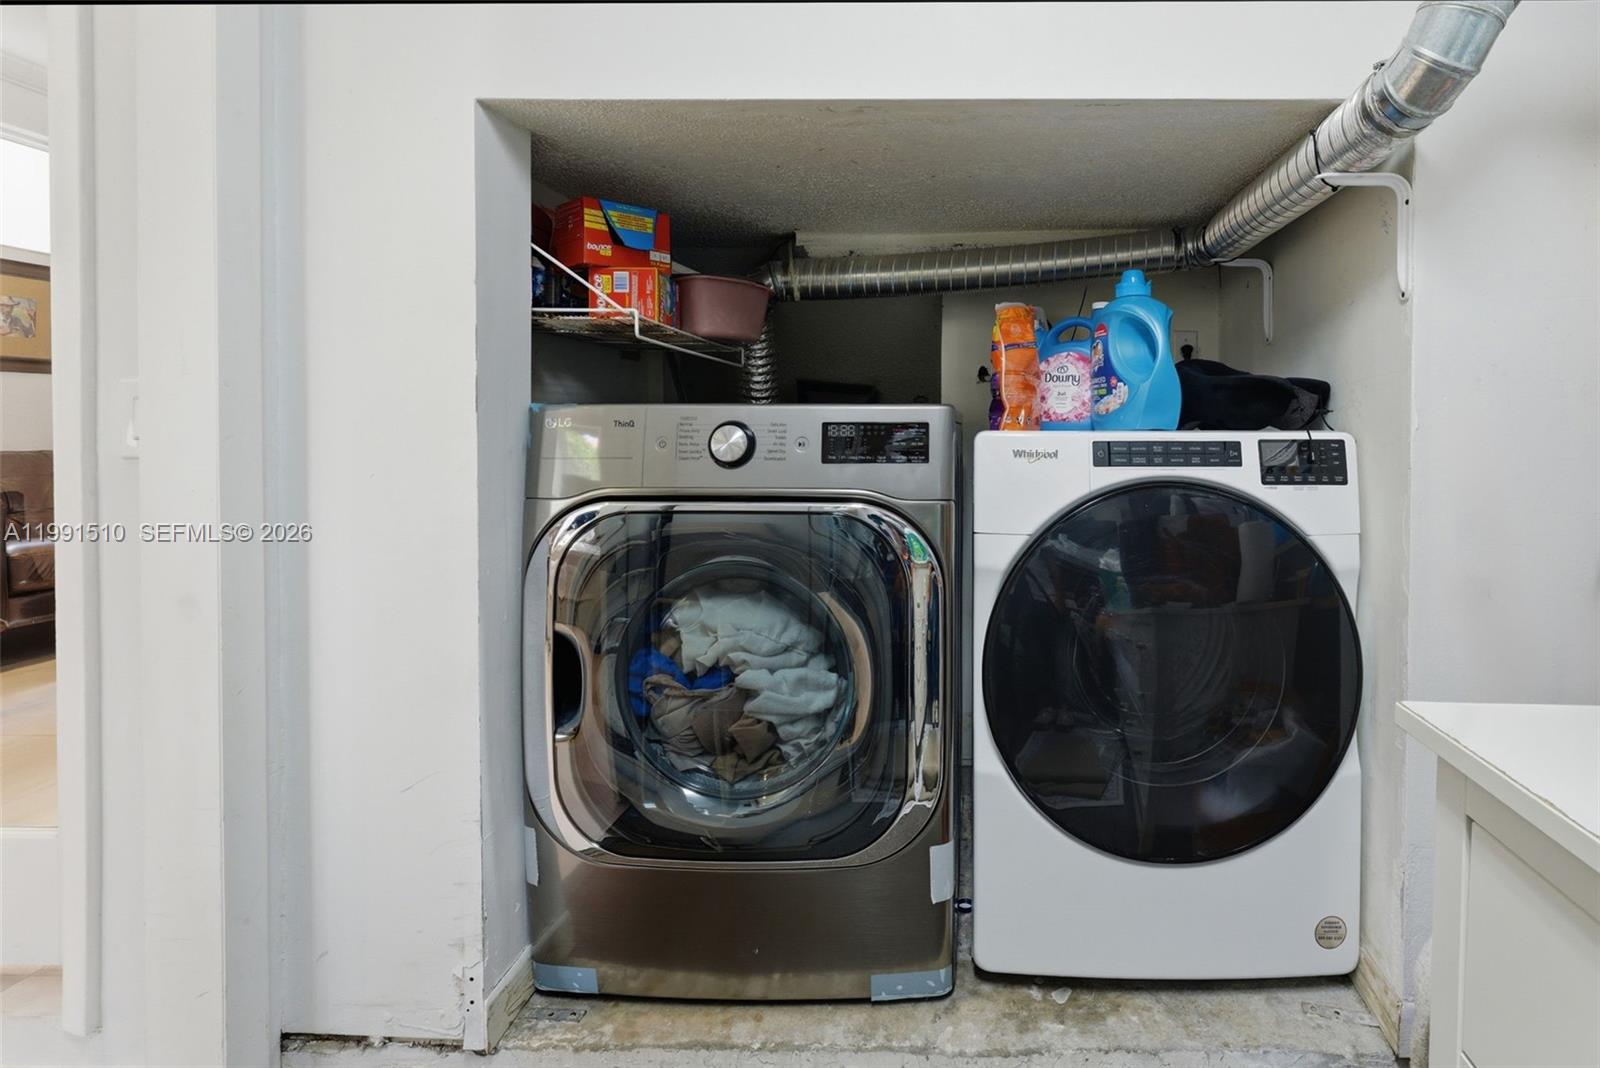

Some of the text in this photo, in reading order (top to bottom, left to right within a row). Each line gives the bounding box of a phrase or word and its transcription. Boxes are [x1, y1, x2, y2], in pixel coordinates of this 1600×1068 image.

[1044, 372, 1080, 386] Downy
[559, 418, 572, 427] LG
[613, 420, 635, 428] ThinQ
[1012, 449, 1059, 462] Whirlpool
